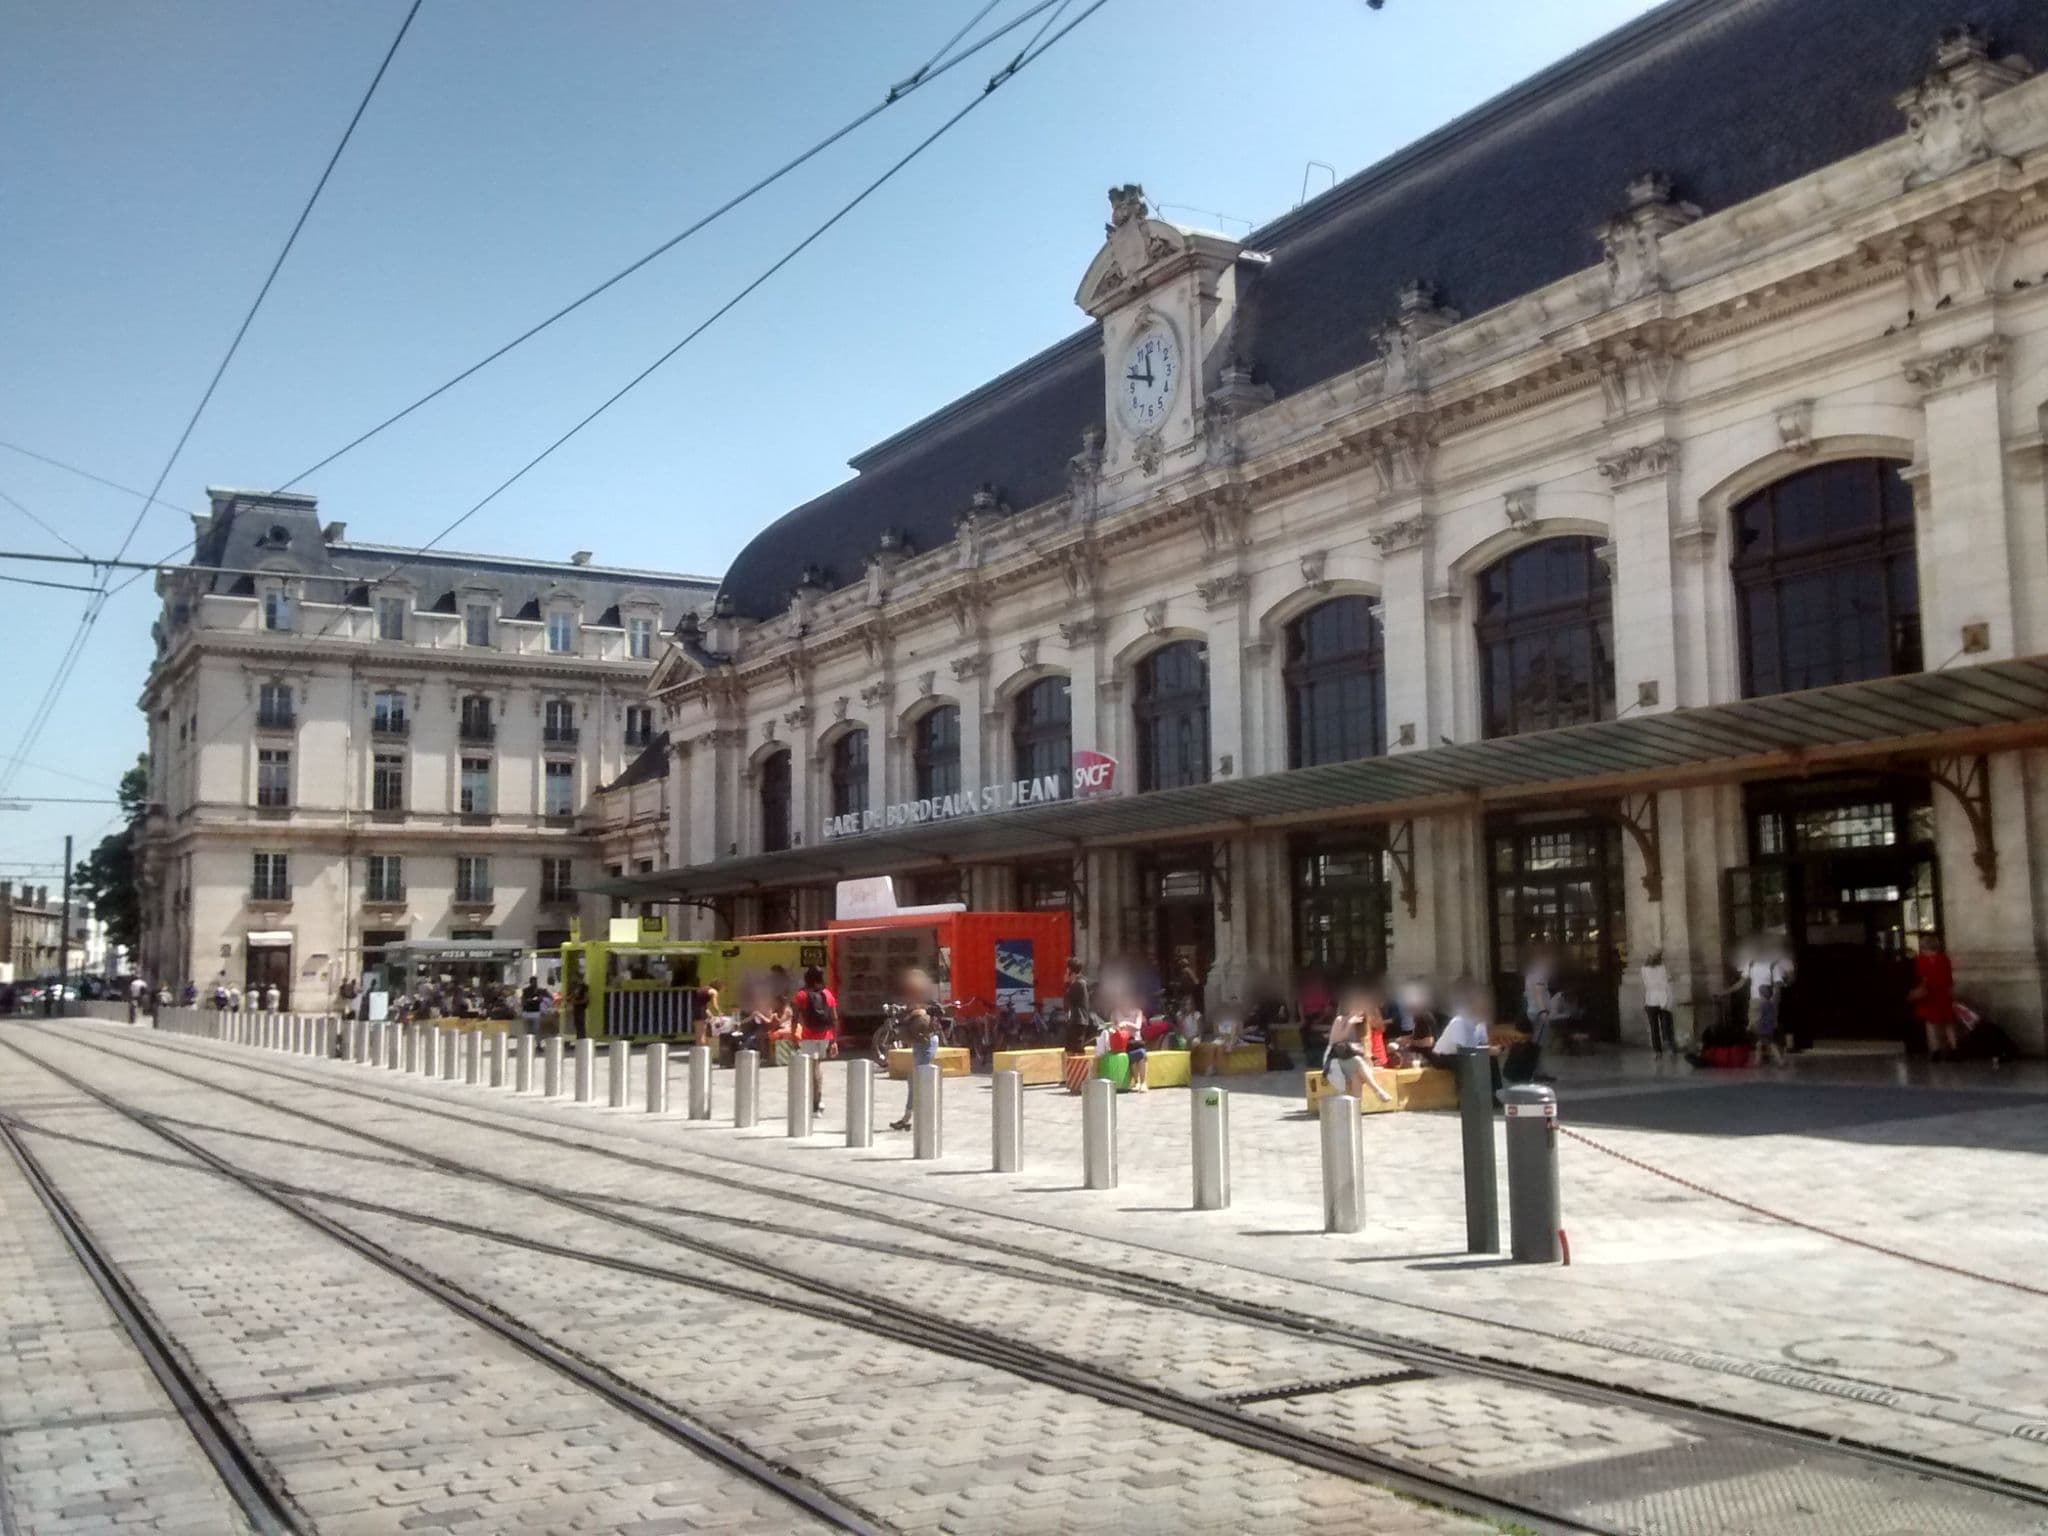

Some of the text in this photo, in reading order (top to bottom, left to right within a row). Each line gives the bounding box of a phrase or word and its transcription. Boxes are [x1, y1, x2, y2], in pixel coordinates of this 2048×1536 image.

[1163, 348, 1169, 361] 2
[1166, 364, 1172, 376] 3
[1130, 382, 1135, 394] 9
[1157, 396, 1163, 409] 5
[1139, 404, 1145, 417] 7
[1148, 405, 1153, 417] 6
[1074, 763, 1111, 789] SNCF
[822, 774, 1059, 838] GARE DE BORDEAUX ST JEAN
